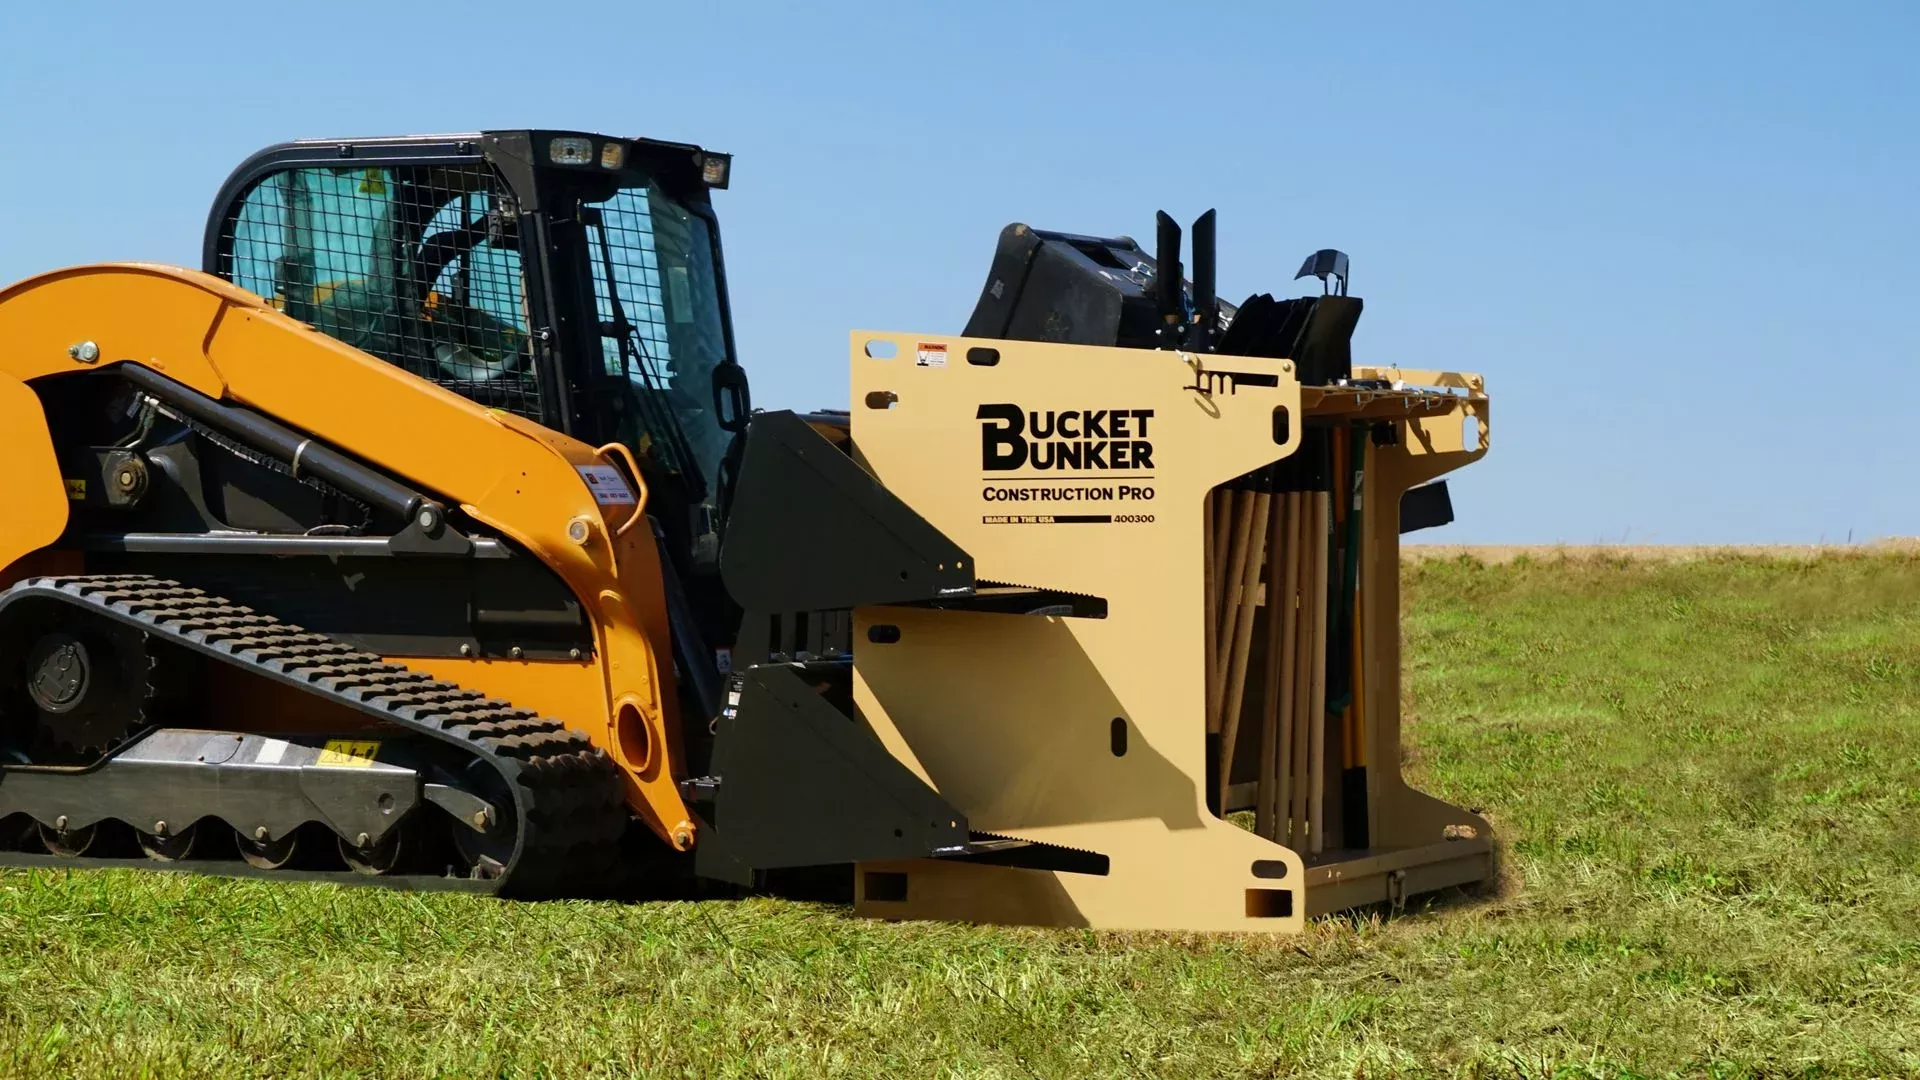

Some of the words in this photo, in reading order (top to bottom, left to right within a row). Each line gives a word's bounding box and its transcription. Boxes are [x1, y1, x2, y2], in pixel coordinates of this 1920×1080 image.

[976, 404, 1155, 439] BUCKET
[982, 438, 1155, 471] BUNKER
[983, 487, 1113, 502] CONSTRUCTION
[1118, 485, 1155, 500] PRO
[984, 516, 1008, 524] MADE
[1010, 516, 1019, 524] IN
[1021, 516, 1036, 524] THE
[1114, 515, 1155, 523] 400300
